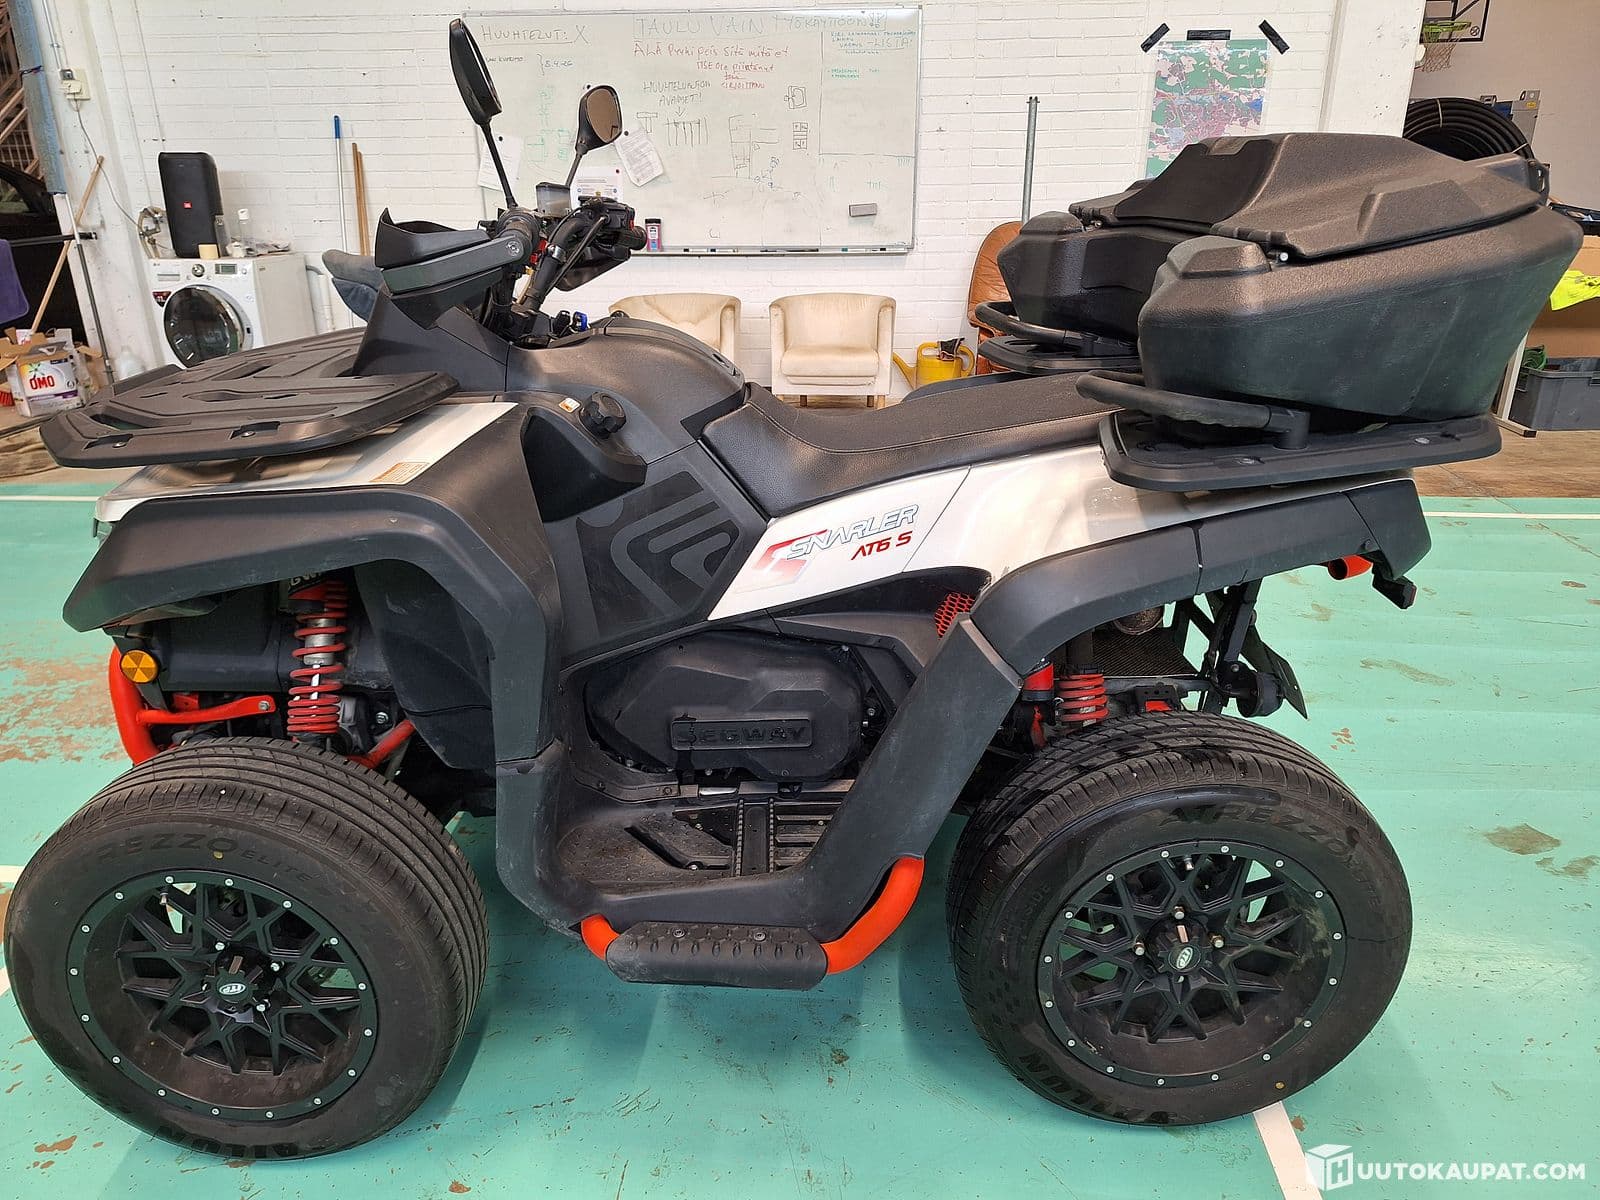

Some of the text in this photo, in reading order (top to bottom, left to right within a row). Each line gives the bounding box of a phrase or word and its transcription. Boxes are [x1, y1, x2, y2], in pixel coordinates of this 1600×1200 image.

[636, 15, 701, 36] TAULU
[709, 15, 765, 35] VAIN
[29, 375, 55, 390] OMO
[786, 503, 919, 560] SNARLER
[851, 530, 913, 560] AT6 S
